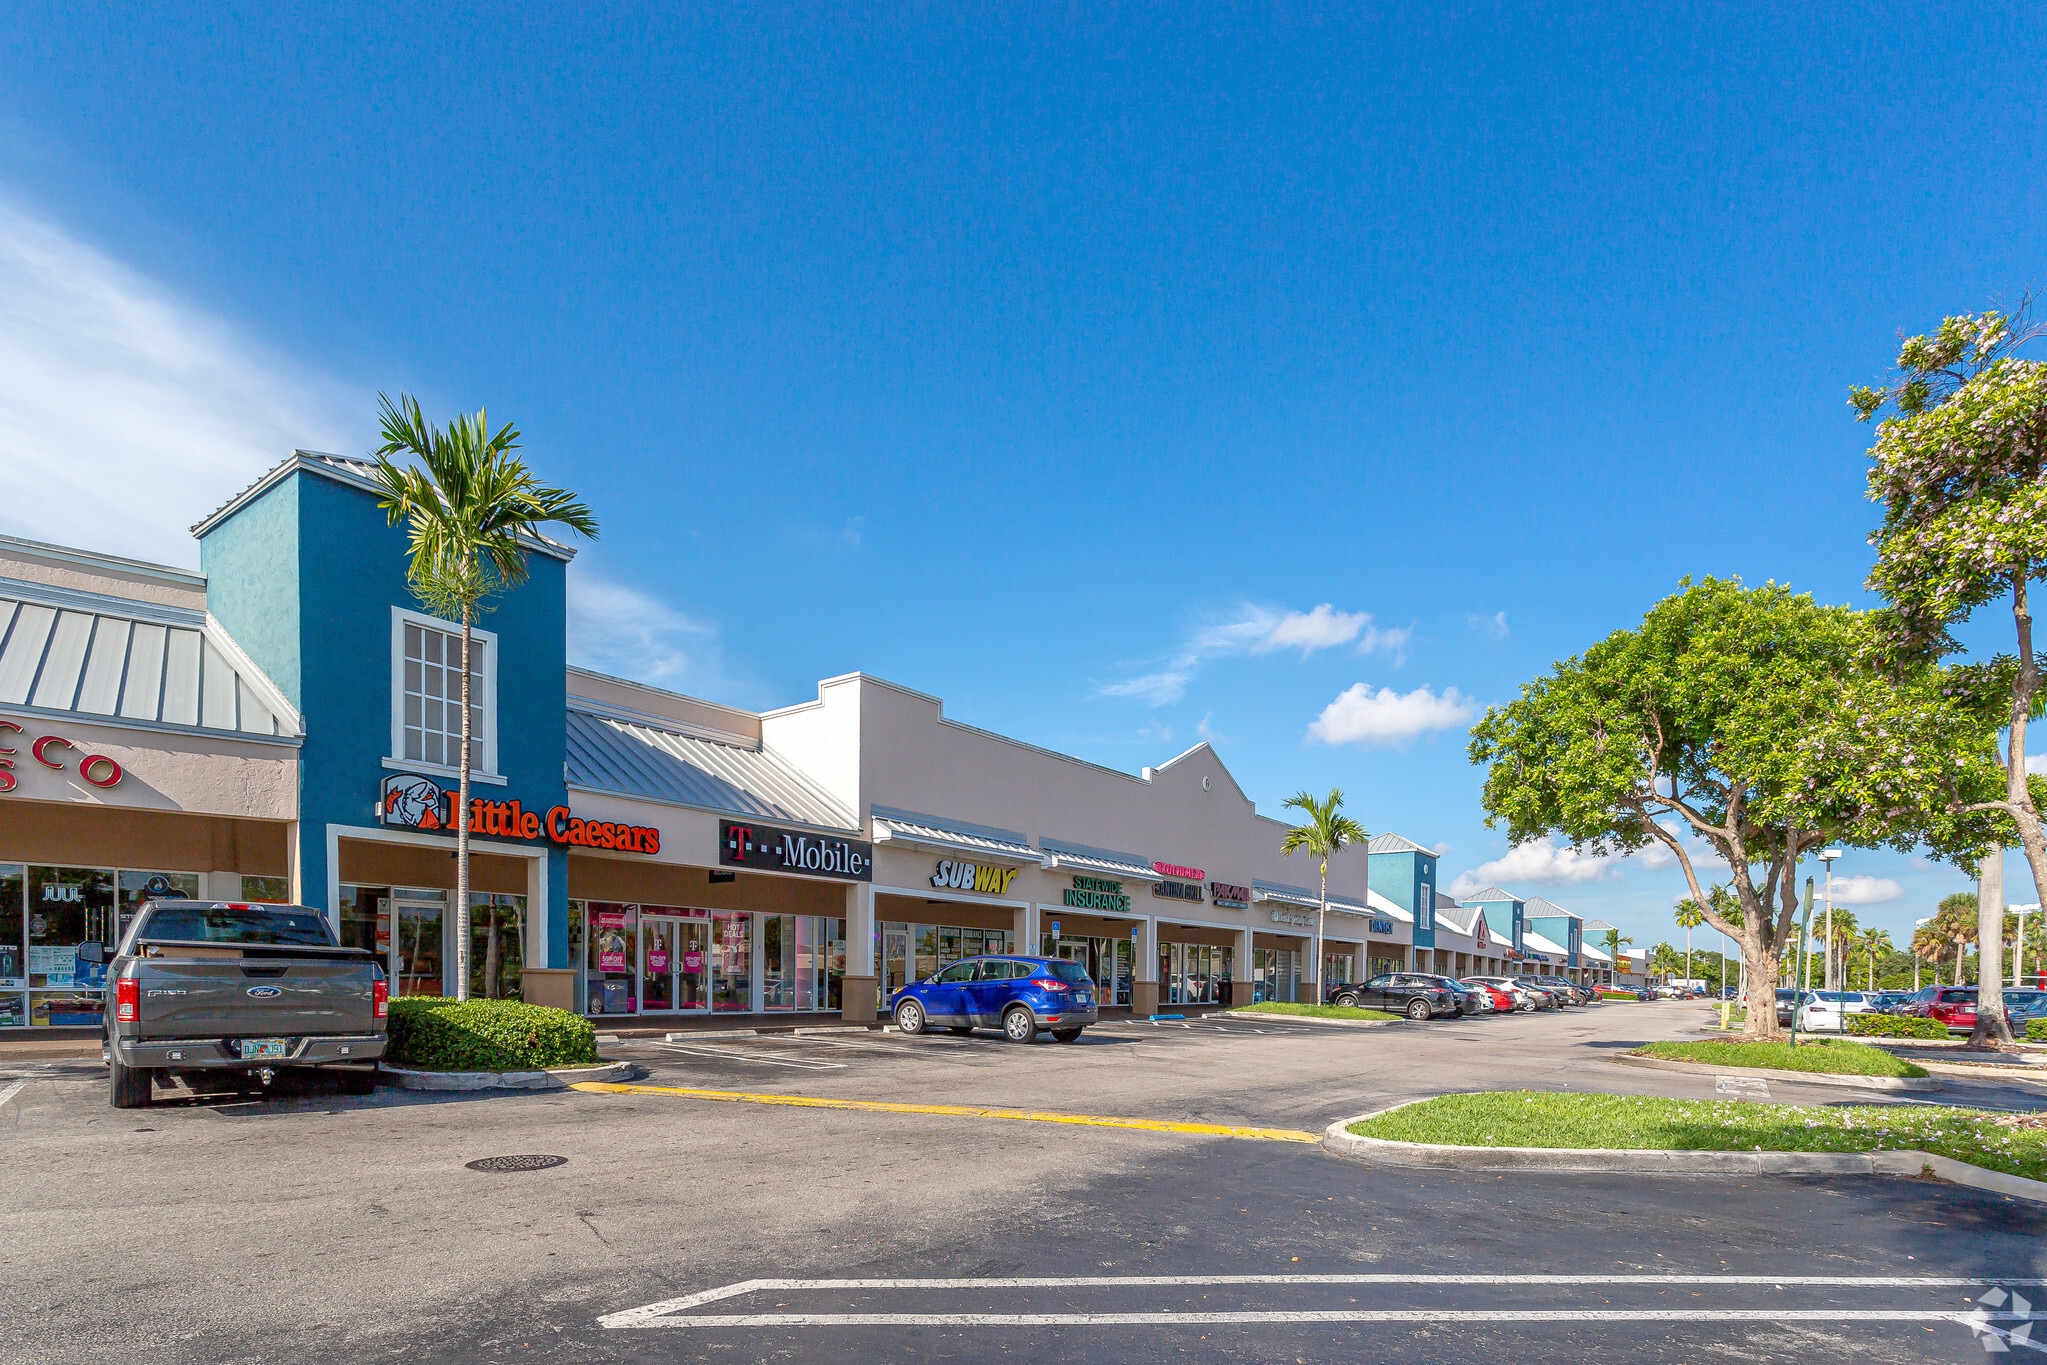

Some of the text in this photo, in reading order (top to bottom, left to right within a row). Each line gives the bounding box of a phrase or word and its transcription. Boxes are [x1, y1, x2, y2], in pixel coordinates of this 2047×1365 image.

[446, 790, 660, 855] Little Caesars
[783, 834, 862, 875] Mobile
[931, 860, 1018, 894] SUBWAY
[1074, 875, 1123, 895] STATEWIDE
[42, 887, 81, 902] JUUL
[1065, 888, 1131, 911] INSURANCE
[1185, 884, 1203, 901] GRILL
[723, 930, 744, 938] DEALS
[727, 923, 740, 931] HOT
[1371, 919, 1394, 934] DENTIST
